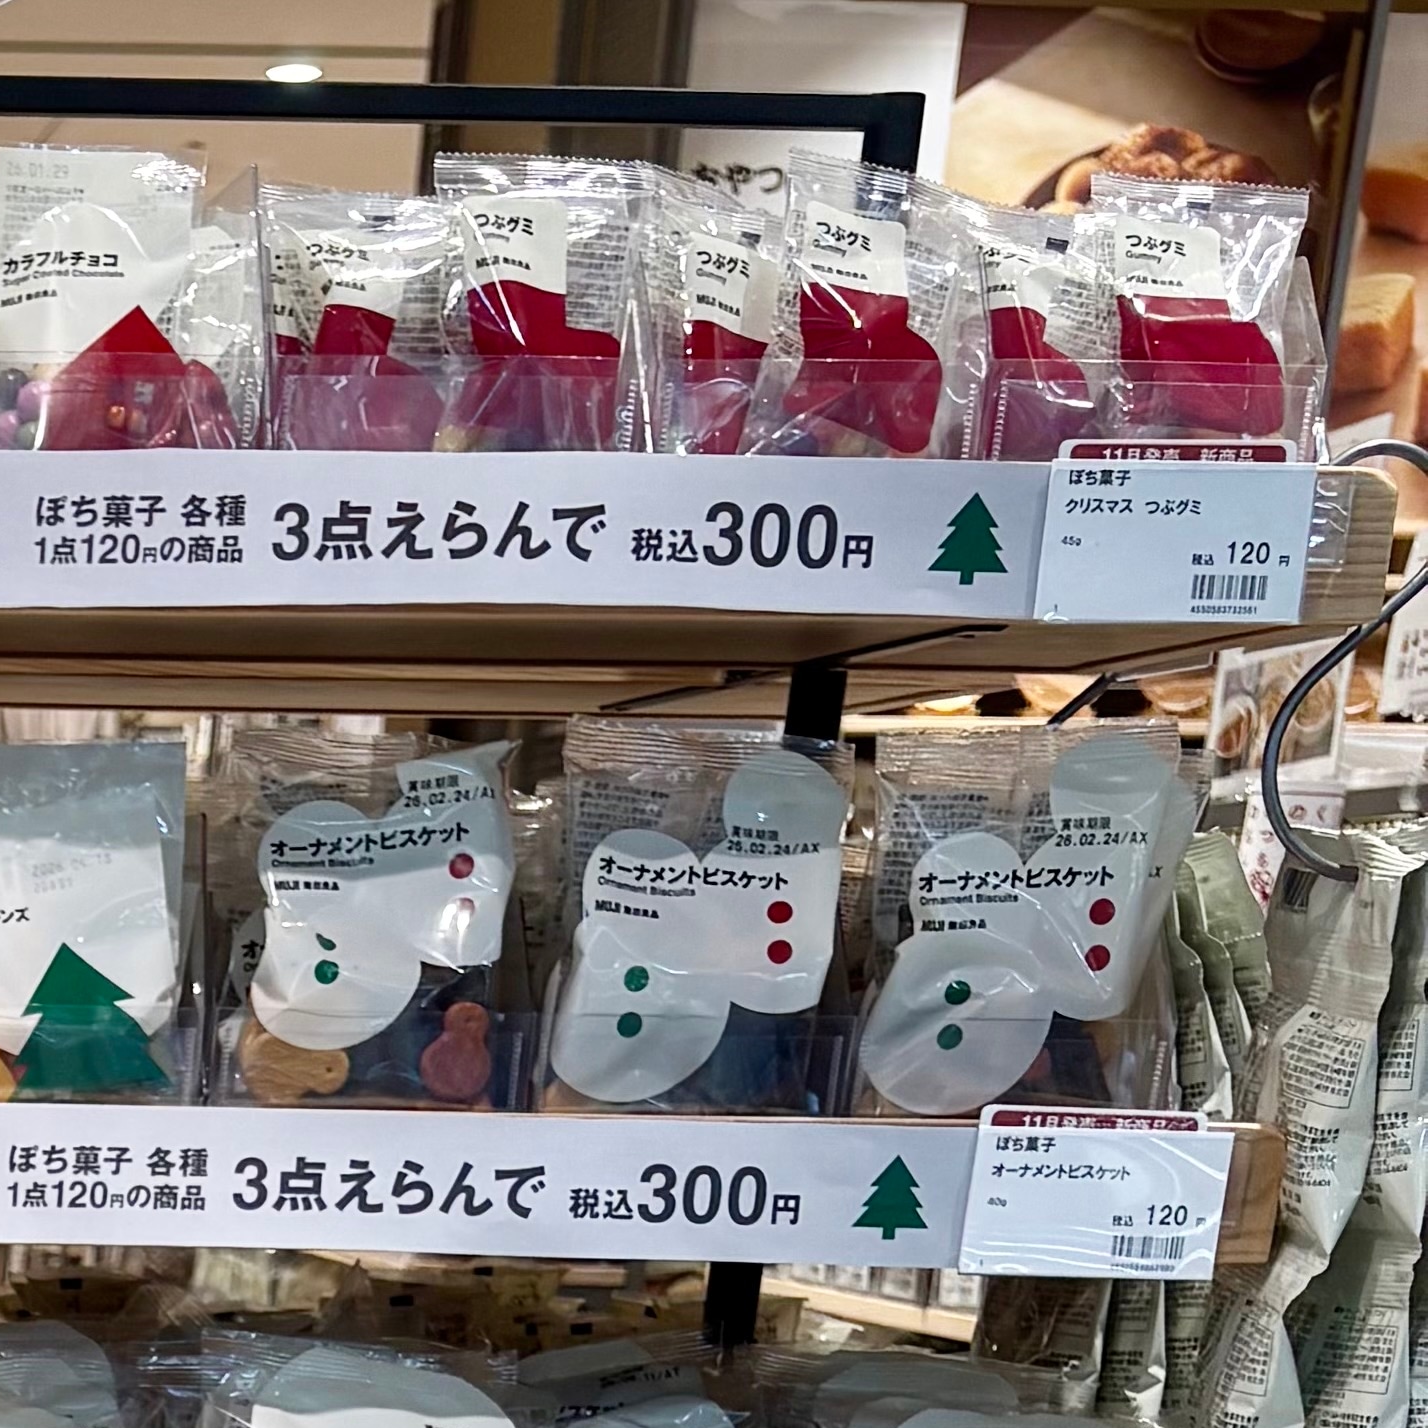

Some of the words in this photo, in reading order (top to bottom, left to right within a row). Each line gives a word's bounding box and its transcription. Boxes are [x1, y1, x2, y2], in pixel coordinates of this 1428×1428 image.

[816, 220, 872, 252] つぶグミ
[1124, 233, 1187, 257] つぶグミ
[3, 252, 119, 276] カラフルチョコ
[35, 496, 166, 527] ぽち菓子
[181, 494, 247, 527] 各種
[1064, 498, 1133, 515] クリスマス
[1145, 498, 1202, 516] つぶグミ
[272, 501, 605, 561] 3点えらんで
[34, 533, 244, 566] 1点120円の商品
[1226, 541, 1271, 565] 120
[270, 822, 469, 856] オーナメントビスケット
[599, 855, 789, 890] オーナメントビスケット
[919, 865, 1114, 890] オーナメントビスケット
[8, 1146, 132, 1176] ぽち菓子
[147, 1146, 209, 1177] 各種
[991, 1163, 1131, 1181] オーナメントビスケット
[7, 1182, 206, 1211] 1点120円の商品
[232, 1157, 545, 1219] 3点えらんで
[1146, 1205, 1188, 1228] 120
